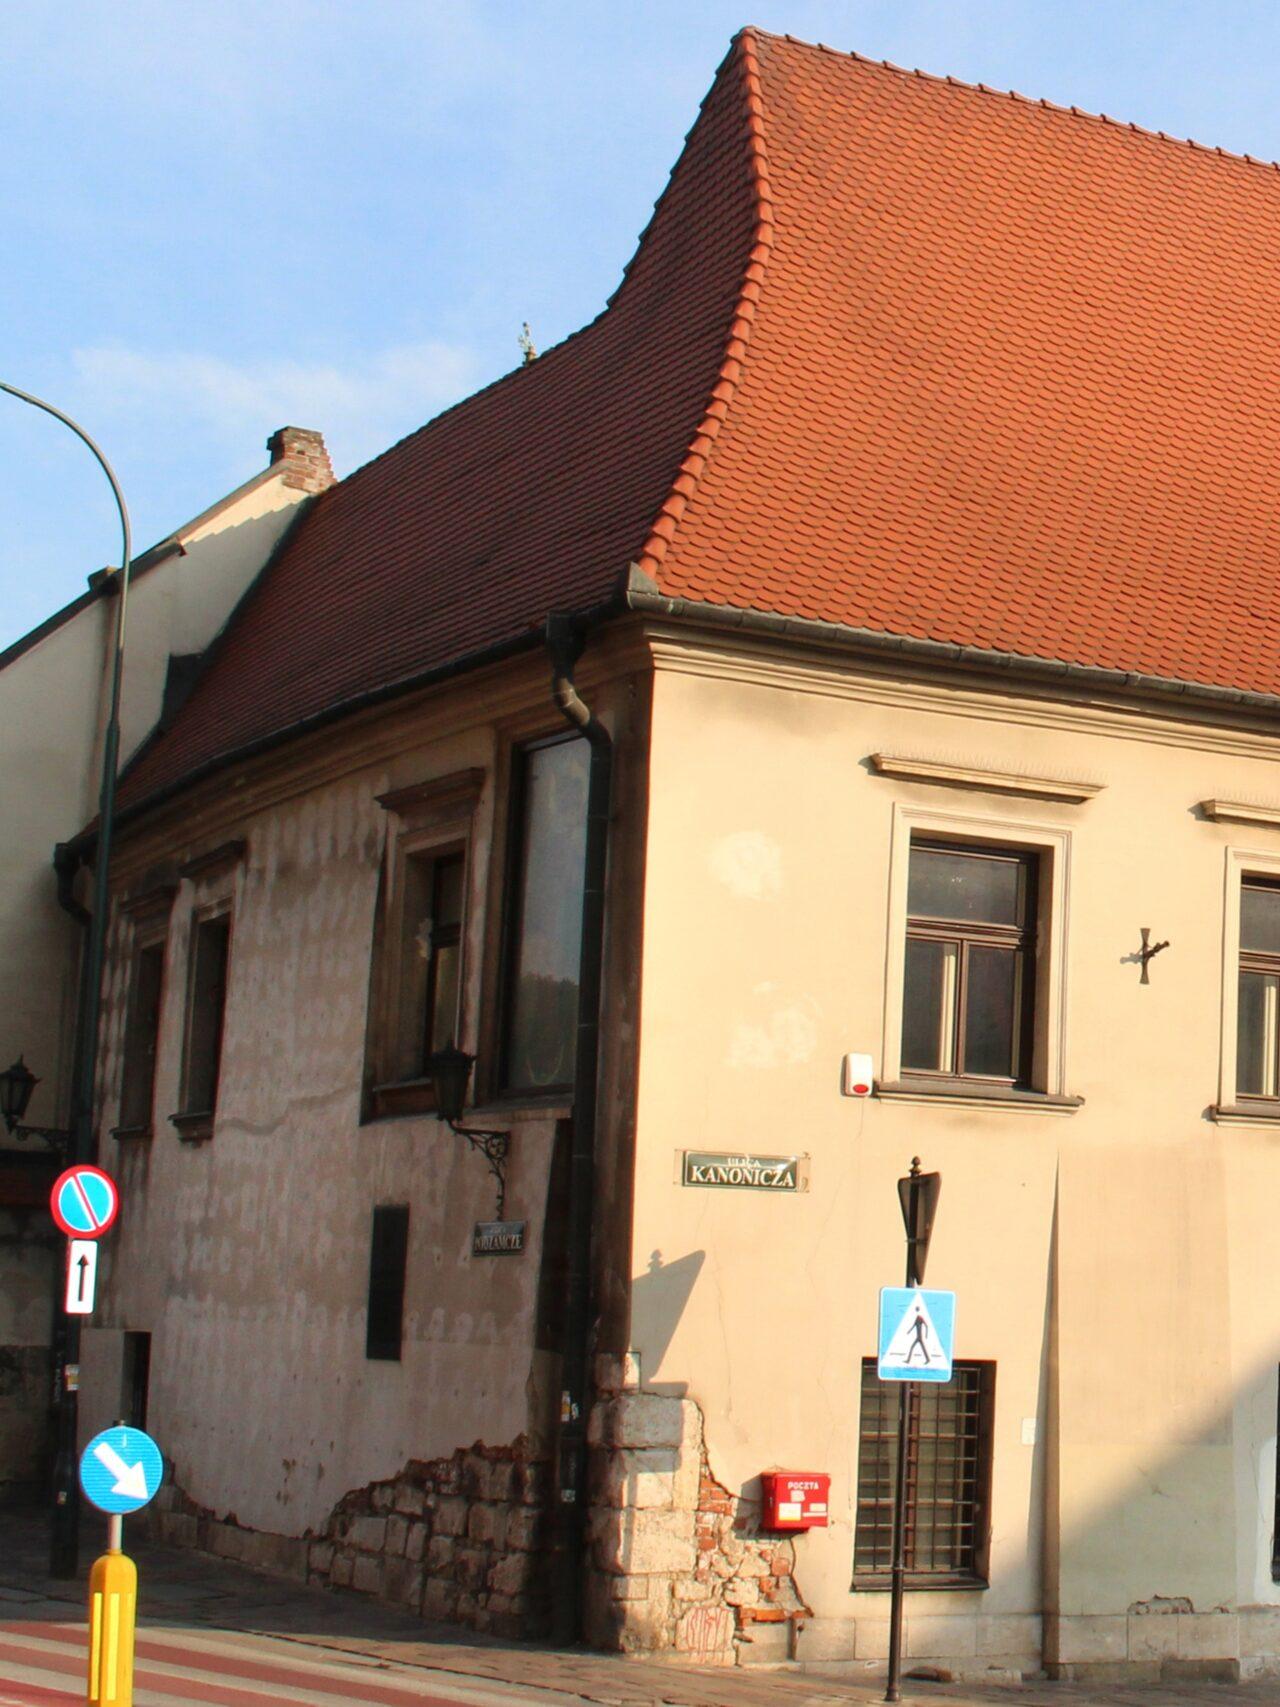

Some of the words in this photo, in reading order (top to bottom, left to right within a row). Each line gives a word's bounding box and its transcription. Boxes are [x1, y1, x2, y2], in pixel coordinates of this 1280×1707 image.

[727, 1157, 761, 1168] ULICA
[690, 1165, 794, 1187] KANONICZA
[787, 1481, 819, 1490] POCZTA
